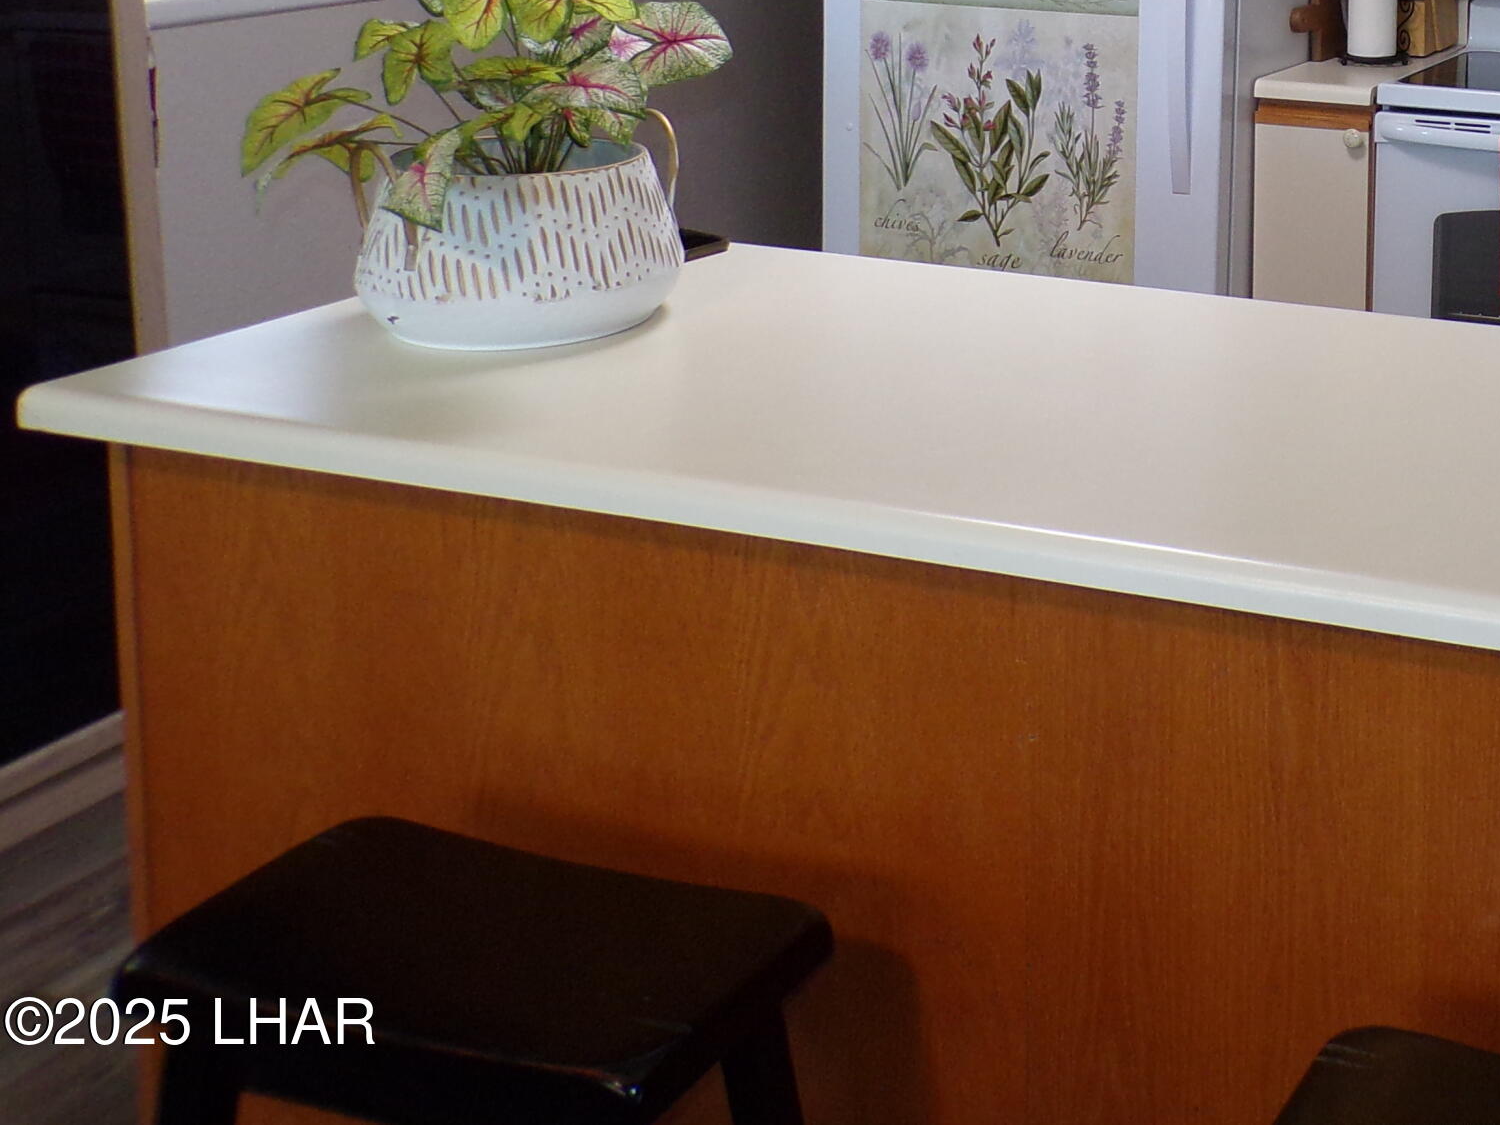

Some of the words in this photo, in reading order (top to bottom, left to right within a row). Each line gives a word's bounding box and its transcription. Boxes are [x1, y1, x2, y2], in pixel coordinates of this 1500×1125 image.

[873, 198, 921, 232] chives
[976, 253, 1024, 272] sage
[1049, 230, 1124, 265] lavender
